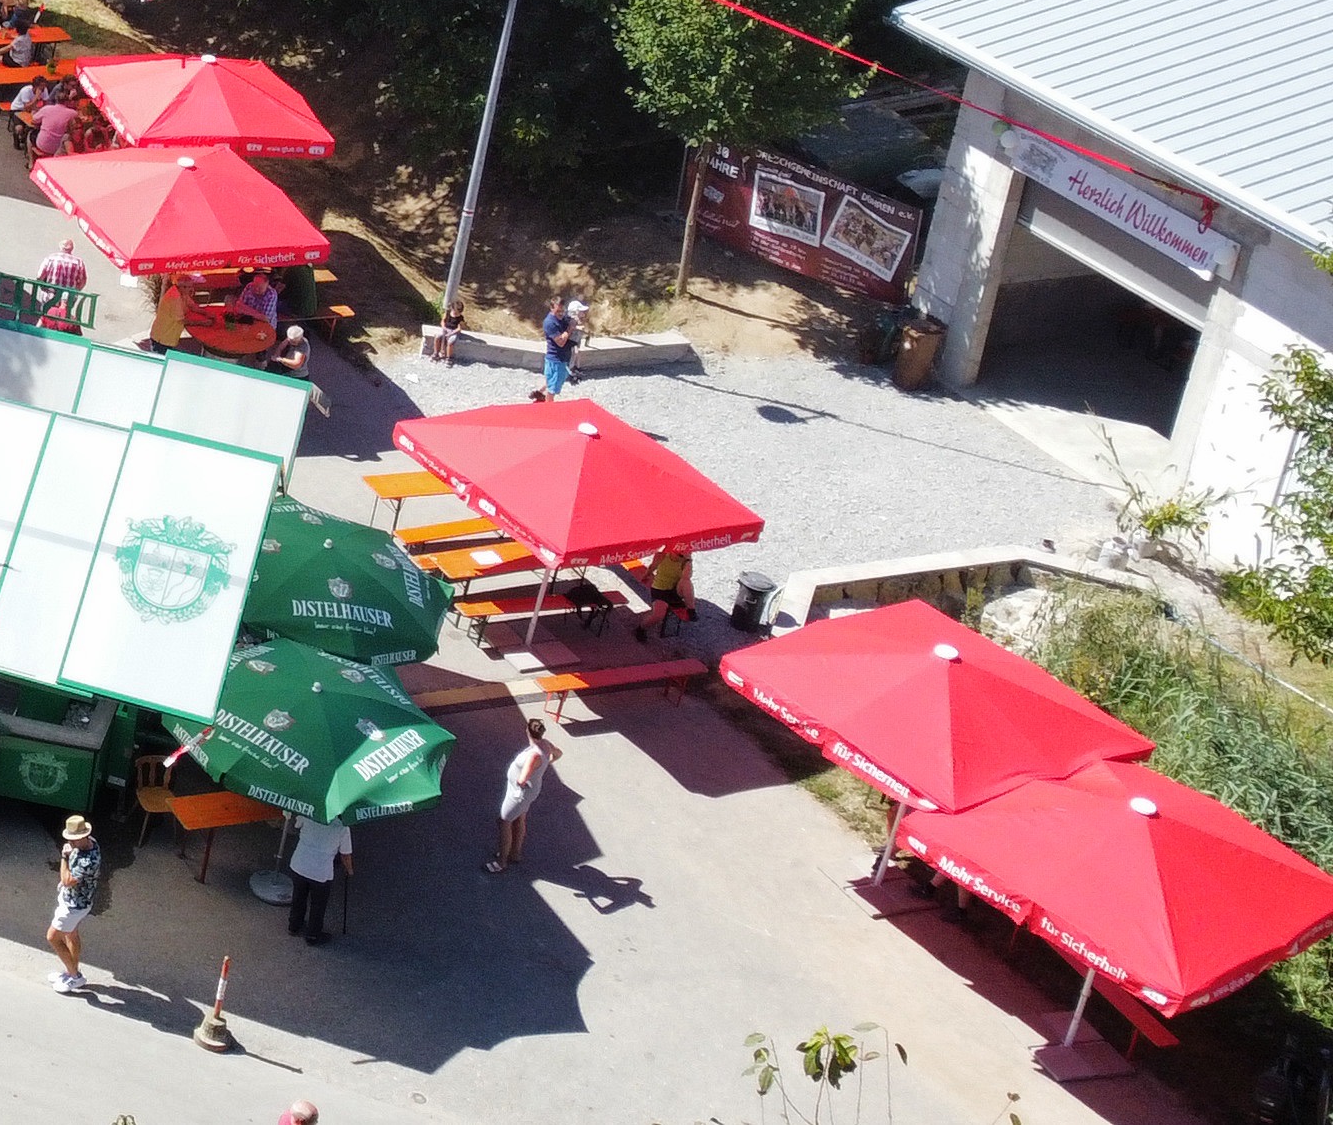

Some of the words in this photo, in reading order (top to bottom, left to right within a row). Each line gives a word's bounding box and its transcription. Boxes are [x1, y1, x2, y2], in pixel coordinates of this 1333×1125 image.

[1068, 169, 1124, 220] Herzlich
[253, 251, 296, 265] Sicherheit
[599, 553, 625, 565] Mehr
[690, 534, 733, 551] Sicherheit
[292, 599, 394, 630] DISTELHÄUSER
[215, 708, 312, 776] DISTELHÄUSER
[938, 855, 974, 886] Mehr
[974, 878, 1022, 914] Service
[1040, 916, 1060, 938] für
[1060, 931, 1129, 982] Sicherheit
